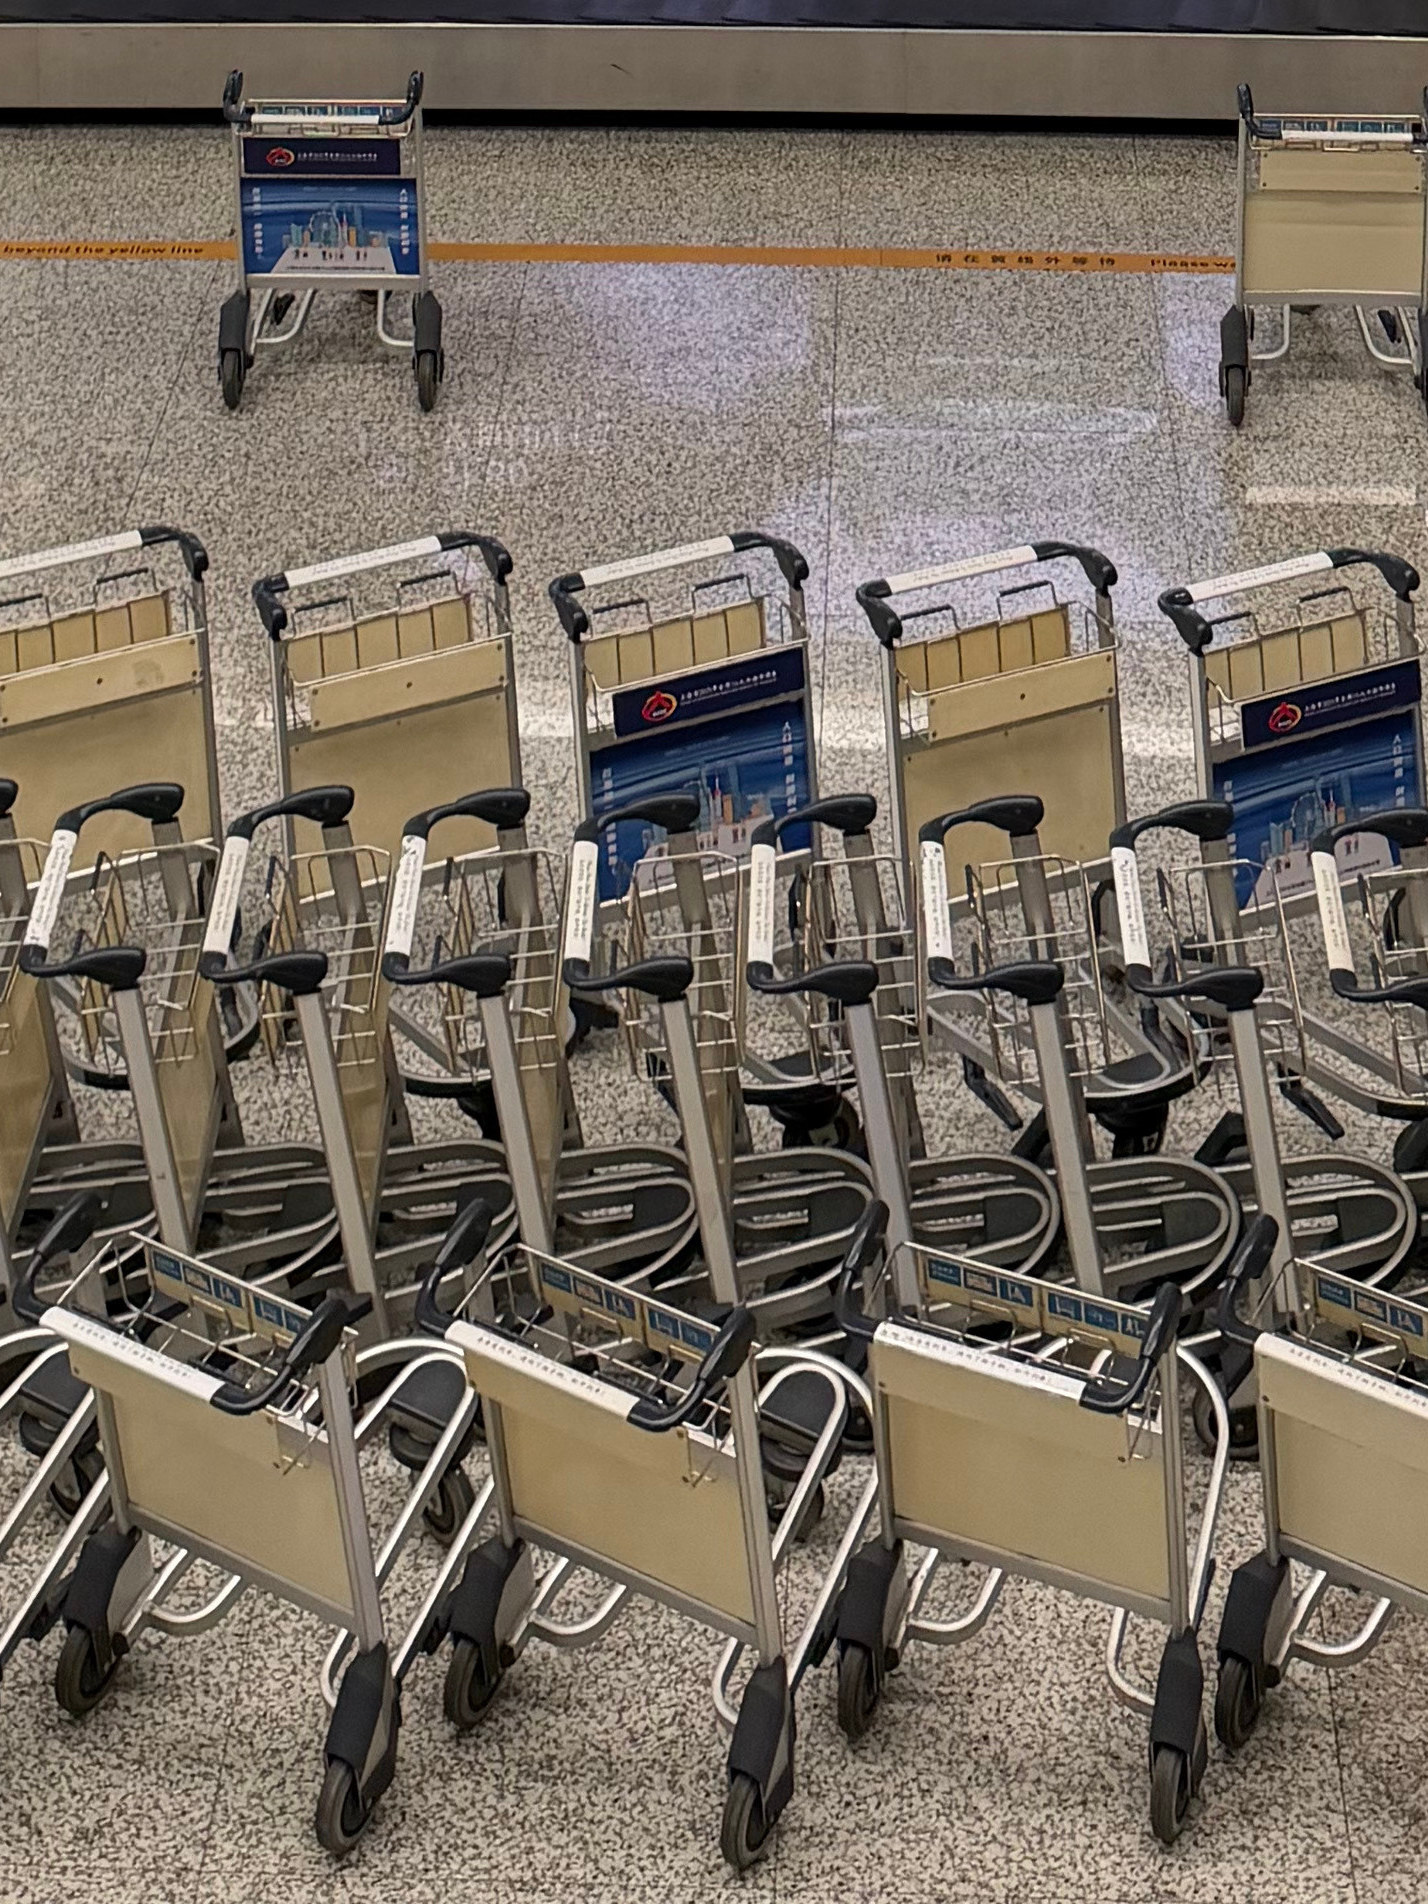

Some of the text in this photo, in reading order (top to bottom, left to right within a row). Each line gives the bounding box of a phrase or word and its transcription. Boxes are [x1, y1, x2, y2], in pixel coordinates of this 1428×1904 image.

[3, 245, 72, 254] beyond
[74, 245, 104, 253] the
[109, 245, 167, 255] yellow
[170, 245, 204, 254] line
[1151, 258, 1210, 268] Please
